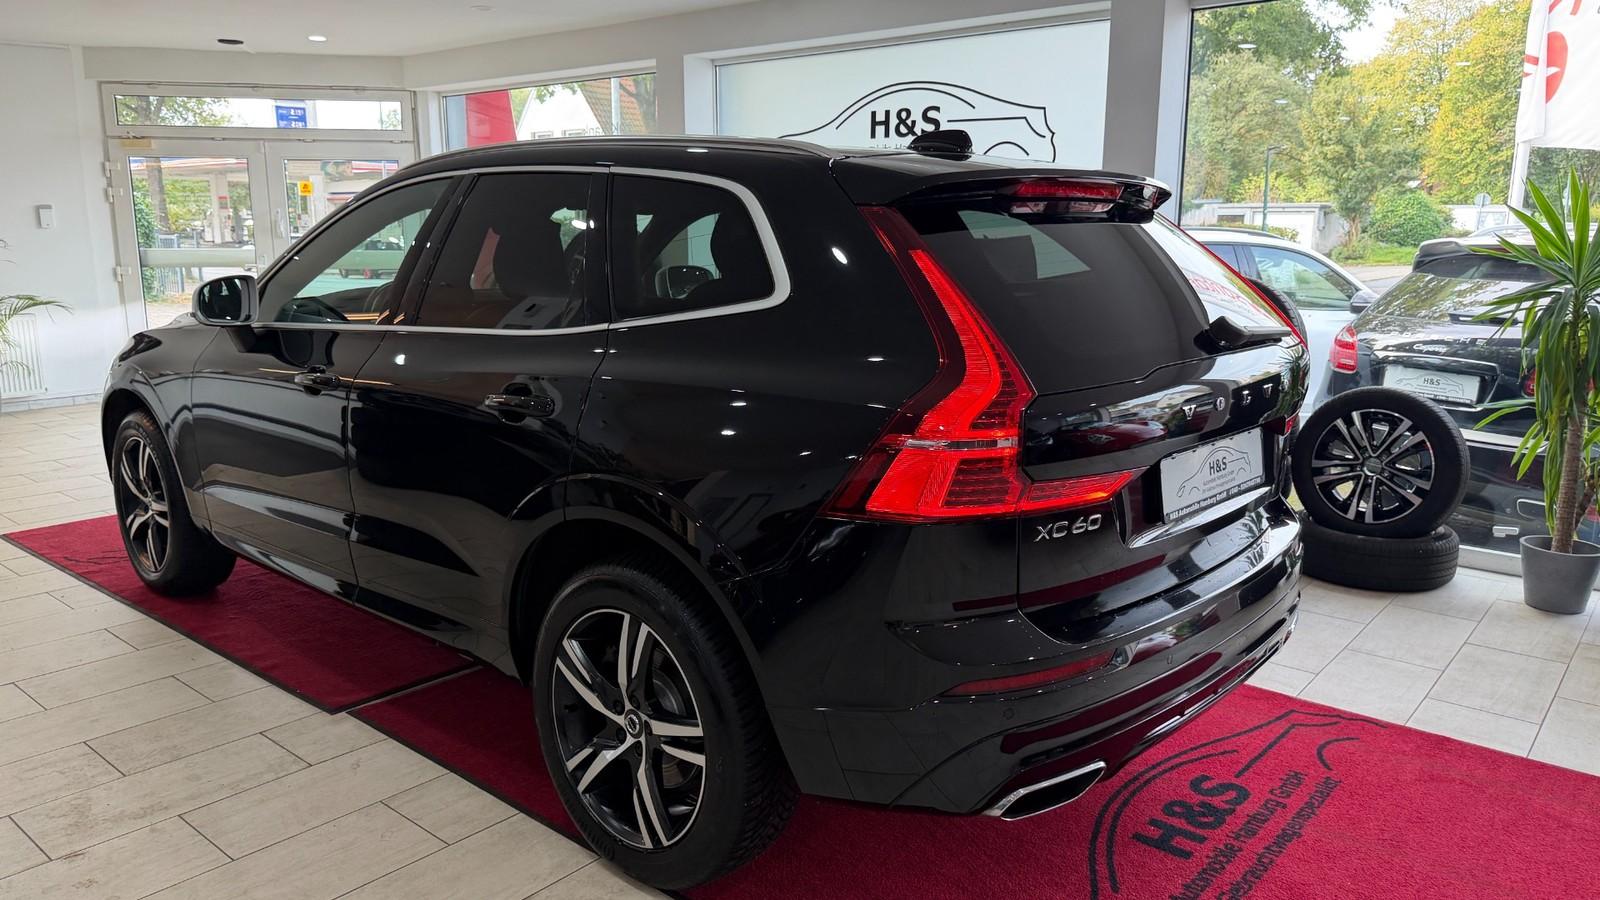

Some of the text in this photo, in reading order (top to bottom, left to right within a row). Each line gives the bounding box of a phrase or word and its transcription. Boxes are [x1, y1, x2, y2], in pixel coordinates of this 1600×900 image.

[870, 105, 941, 140] H&S
[1423, 377, 1441, 386] H&S
[1208, 456, 1227, 476] H&S
[1131, 773, 1251, 860] H&S
